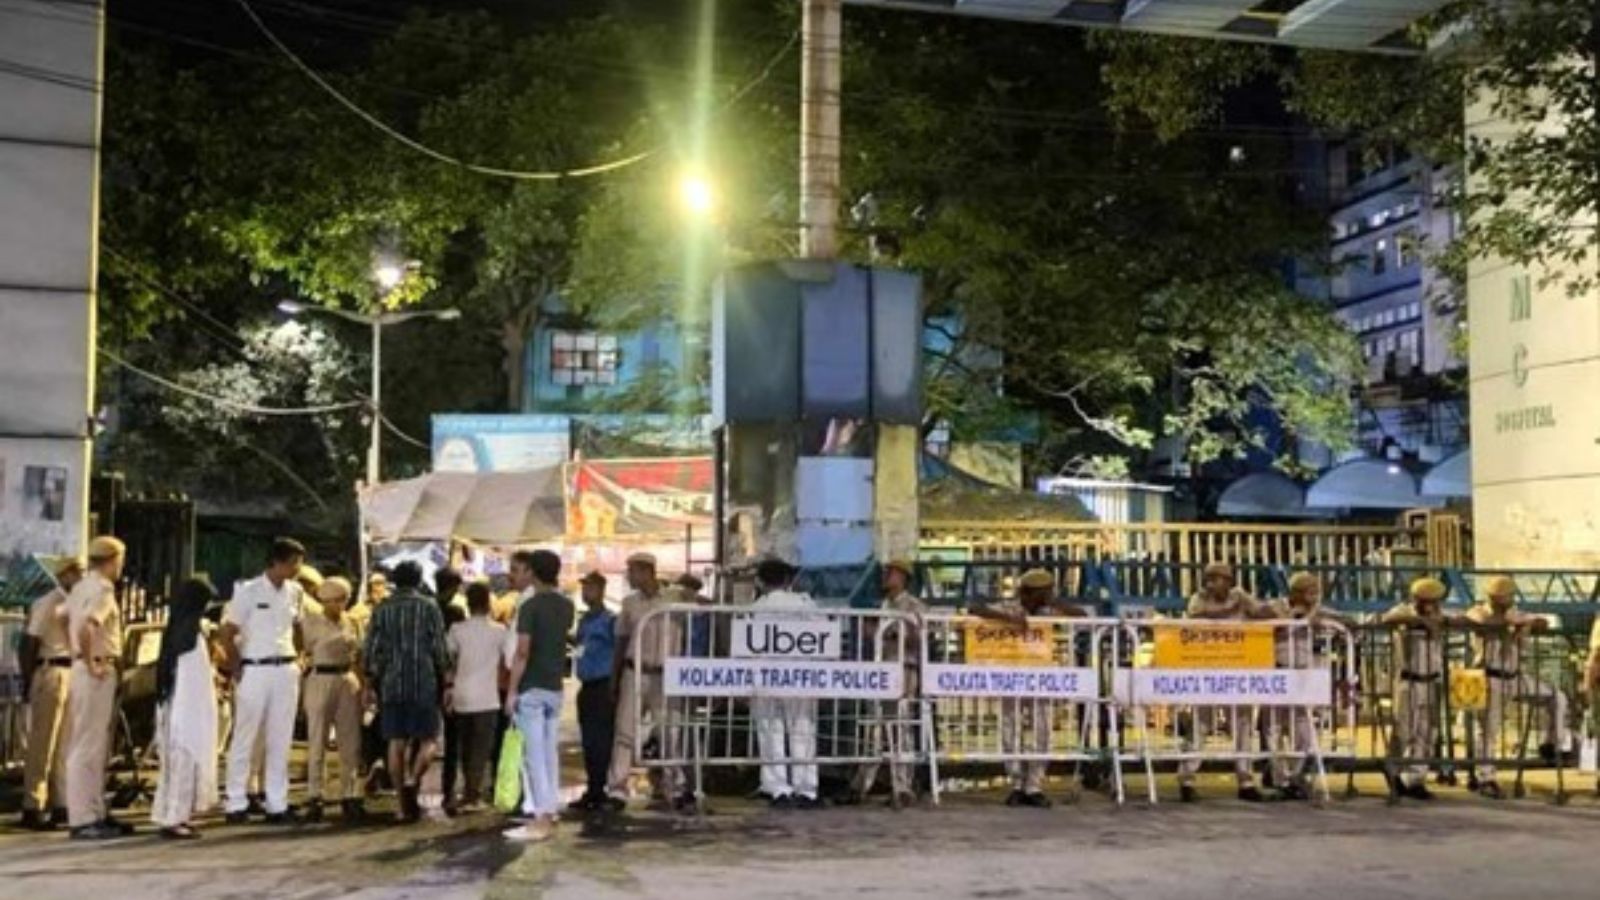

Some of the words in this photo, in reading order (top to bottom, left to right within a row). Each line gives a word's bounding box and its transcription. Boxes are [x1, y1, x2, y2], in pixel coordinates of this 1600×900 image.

[746, 623, 830, 655] Uber
[679, 667, 754, 686] KOLKATA
[760, 669, 828, 688] TRAFFIC
[832, 671, 889, 690] POLICE
[938, 671, 987, 691] KOLKATA
[990, 672, 1035, 692] TRAFFIC
[1039, 673, 1078, 692] POLICE
[1153, 675, 1199, 694] KOLKATA
[1203, 675, 1247, 694] TRAFFIC
[1249, 674, 1287, 694] POLICE
